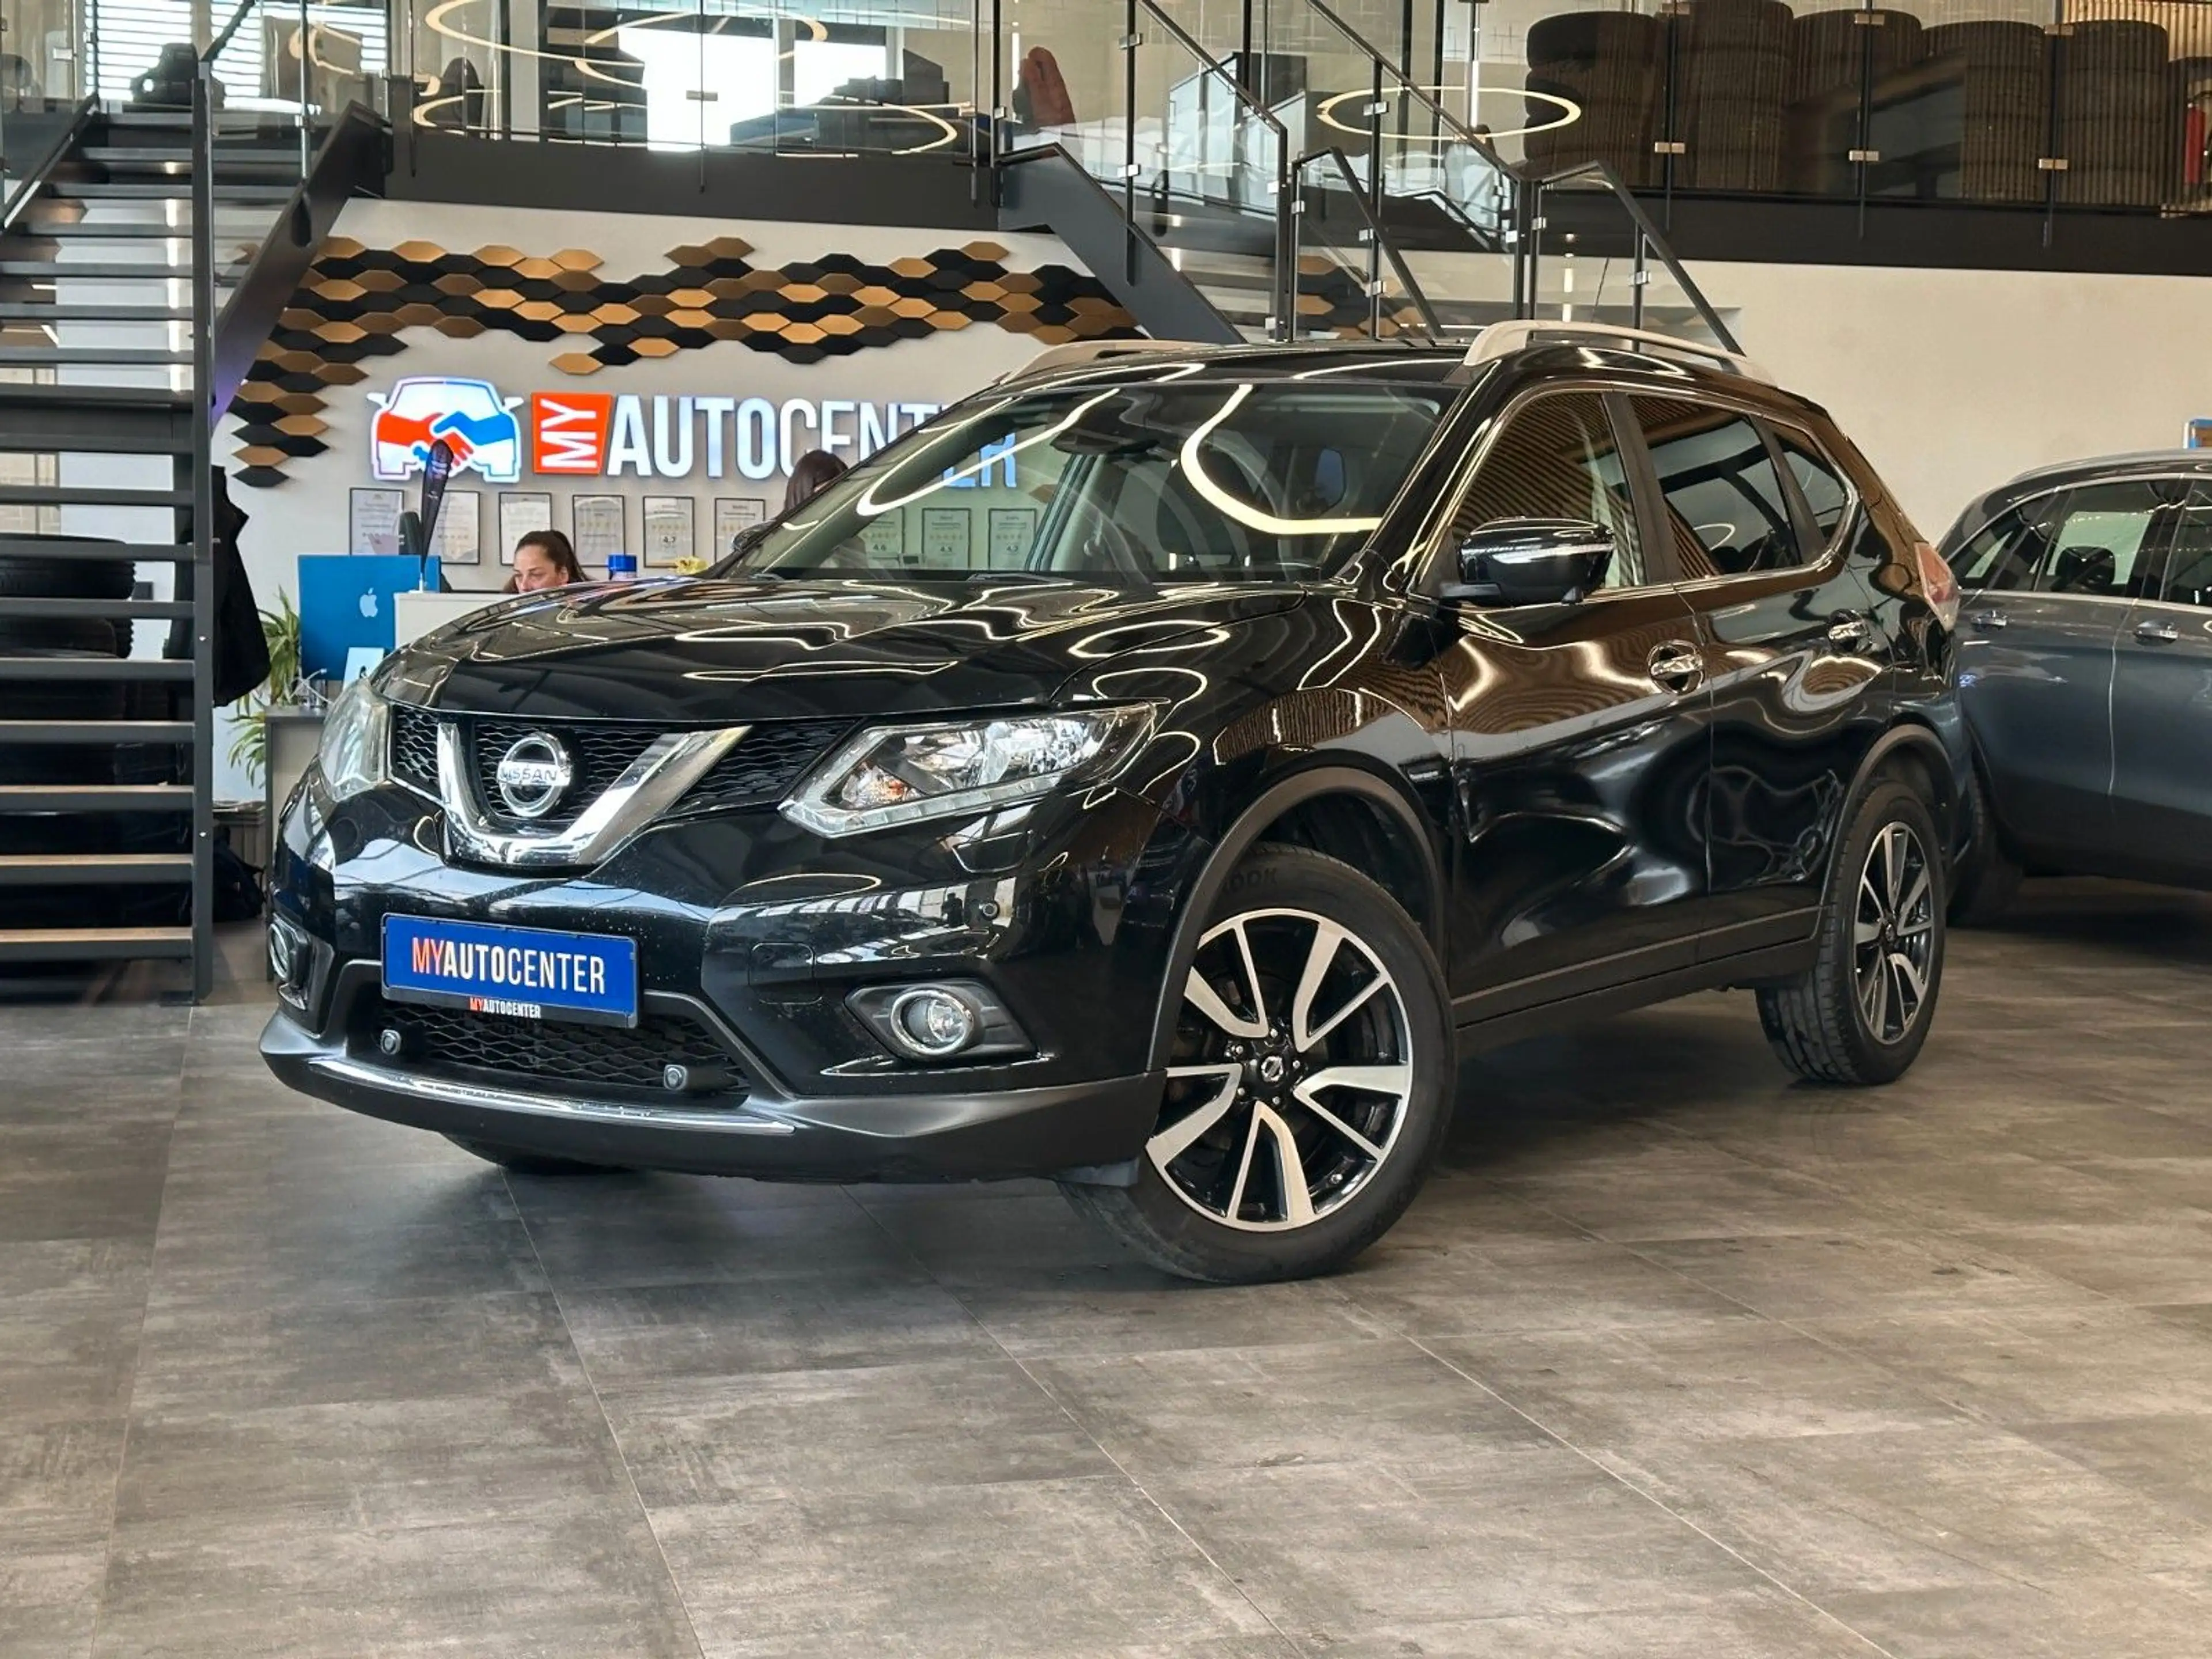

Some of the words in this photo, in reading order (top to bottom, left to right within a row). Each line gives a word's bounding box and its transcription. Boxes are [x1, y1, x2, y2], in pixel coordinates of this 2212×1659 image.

[540, 398, 597, 468] MY
[500, 765, 557, 781] NISSAN
[412, 937, 605, 994] MYAUTOCENTER
[469, 996, 541, 1019] MYAUTOCENTER
